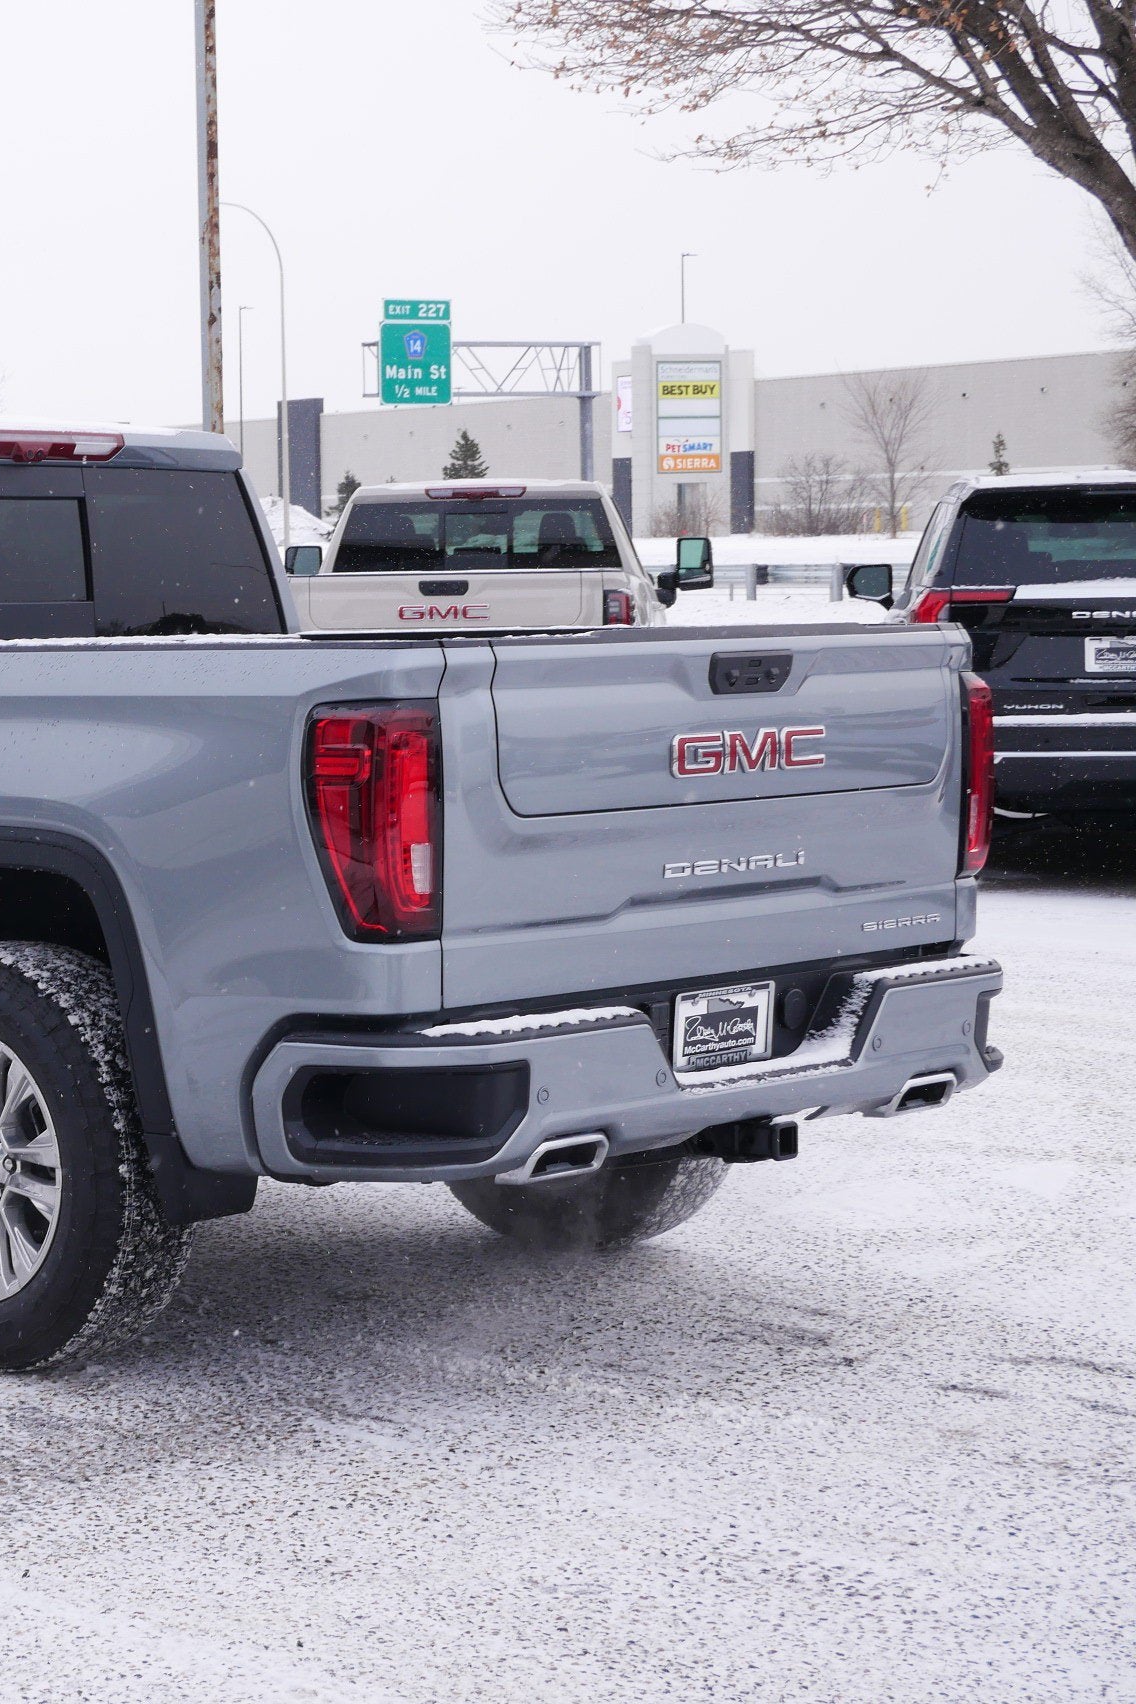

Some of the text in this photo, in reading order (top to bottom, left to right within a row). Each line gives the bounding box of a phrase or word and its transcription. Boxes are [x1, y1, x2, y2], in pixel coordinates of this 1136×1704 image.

[388, 303, 446, 317] EXIT 227
[410, 339, 422, 353] 14
[385, 365, 447, 379] Main St
[415, 386, 438, 397] MILE
[662, 383, 716, 395] BEST BUY
[676, 457, 716, 469] SIERRA
[397, 603, 491, 621] GMC
[1072, 610, 1136, 619] DEN
[670, 725, 826, 779] GMC
[663, 851, 806, 879] DENALI
[861, 913, 943, 933] SIERRA
[699, 986, 752, 998] MINNESOTA
[684, 1037, 754, 1054] McCarthyauto.com
[696, 1051, 746, 1068] MCCARTHY
